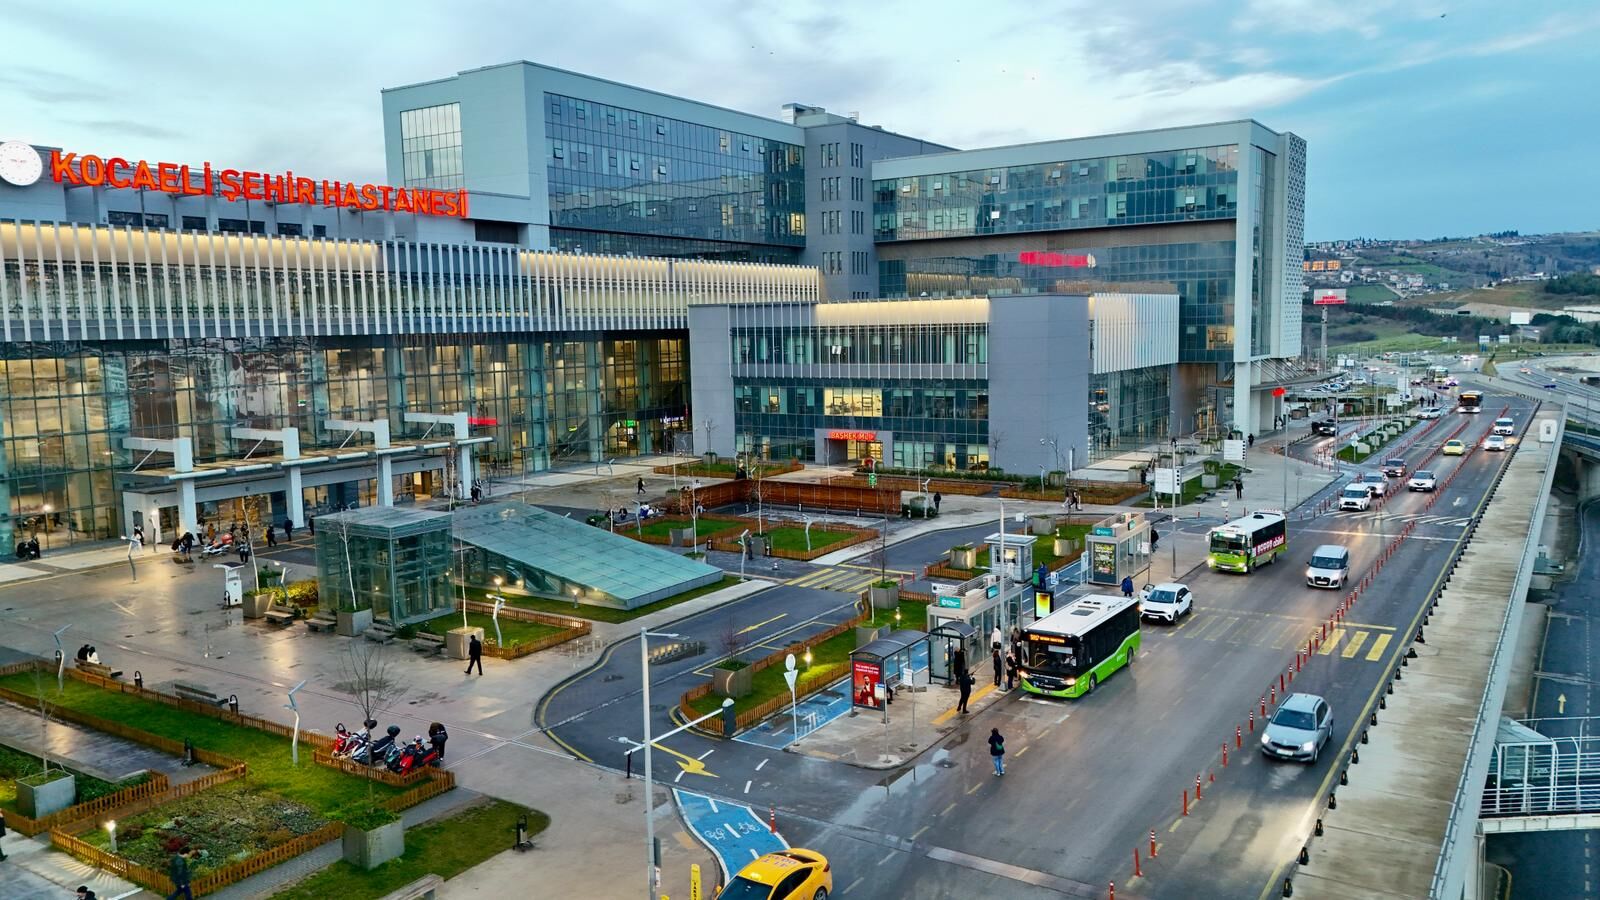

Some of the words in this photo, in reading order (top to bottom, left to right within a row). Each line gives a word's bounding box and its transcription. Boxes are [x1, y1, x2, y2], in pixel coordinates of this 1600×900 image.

[50, 149, 212, 196] KOCAELİ
[219, 168, 316, 205] ŞEHİR
[322, 179, 468, 218] HASTANESİ
